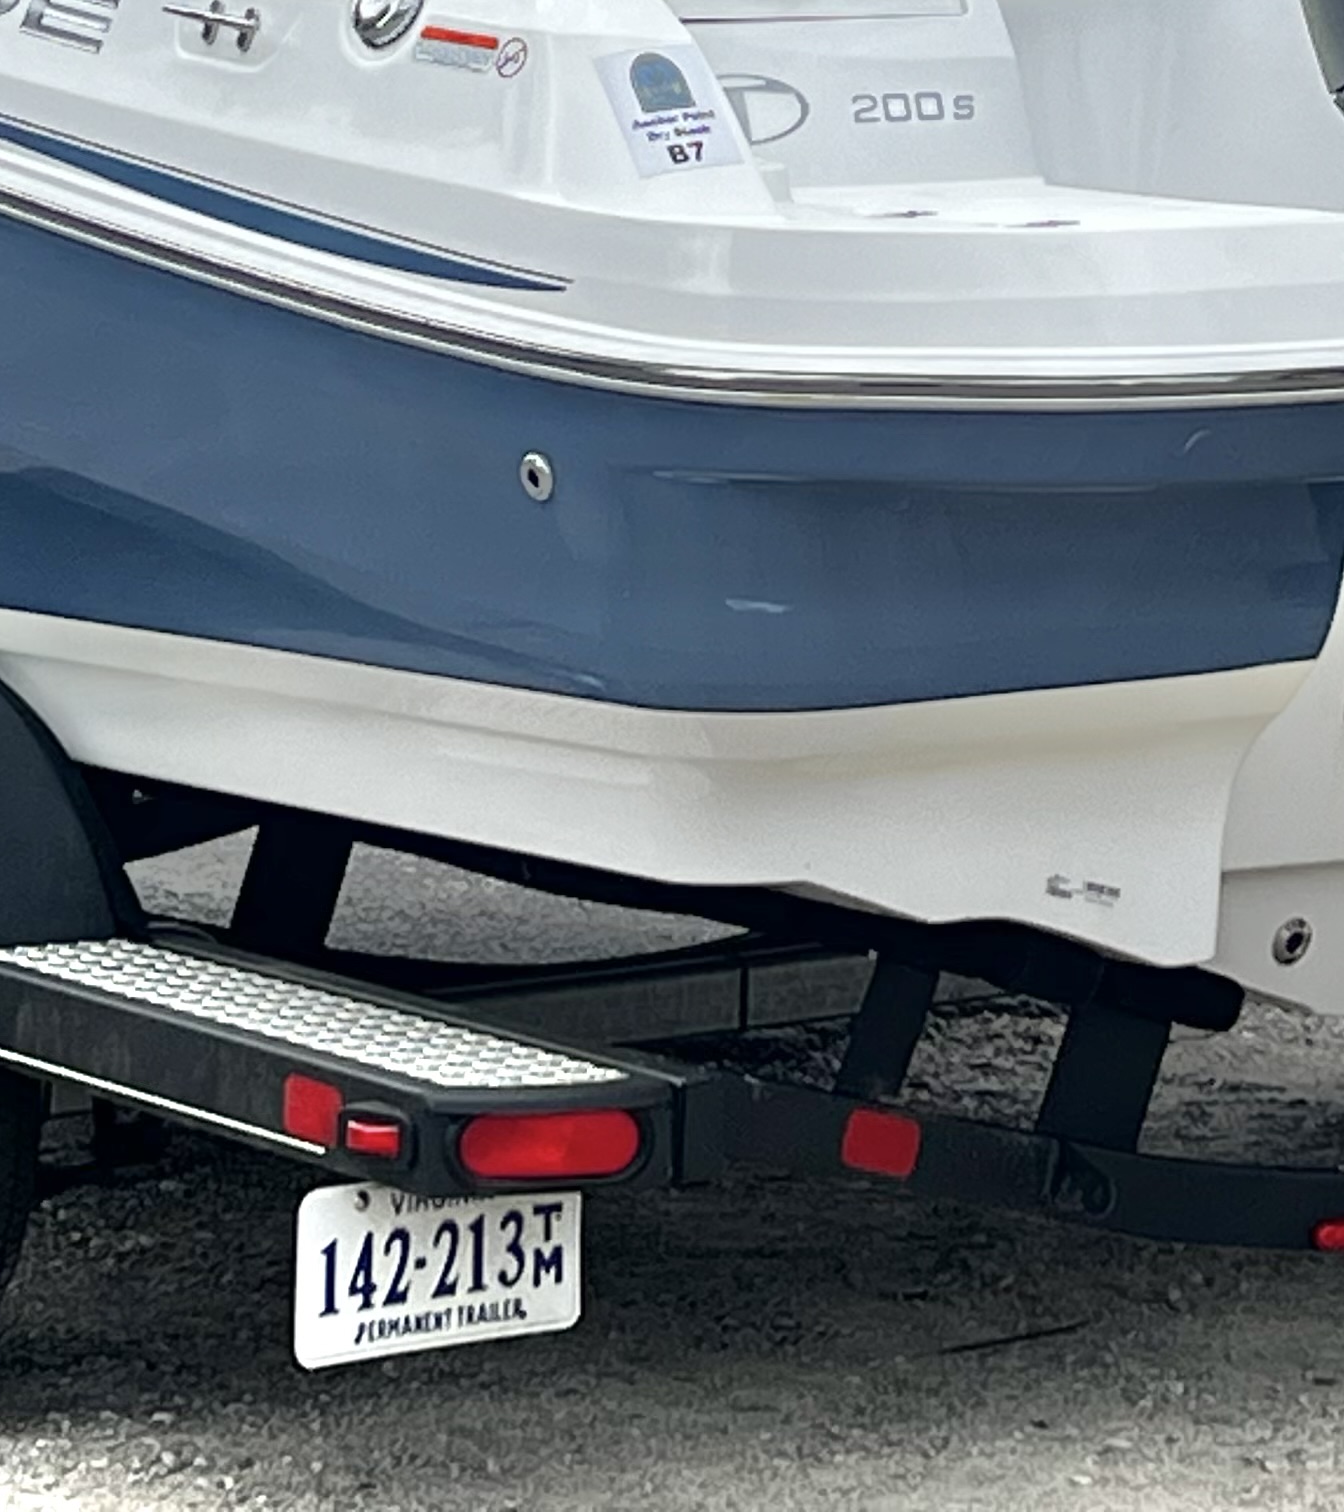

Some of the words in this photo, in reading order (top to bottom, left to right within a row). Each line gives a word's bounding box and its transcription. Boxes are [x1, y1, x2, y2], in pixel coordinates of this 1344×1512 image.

[667, 141, 704, 165] B7
[319, 1209, 526, 1318] 142-213
[354, 1307, 452, 1345] PERMANENT
[457, 1297, 524, 1328] TRAILER
